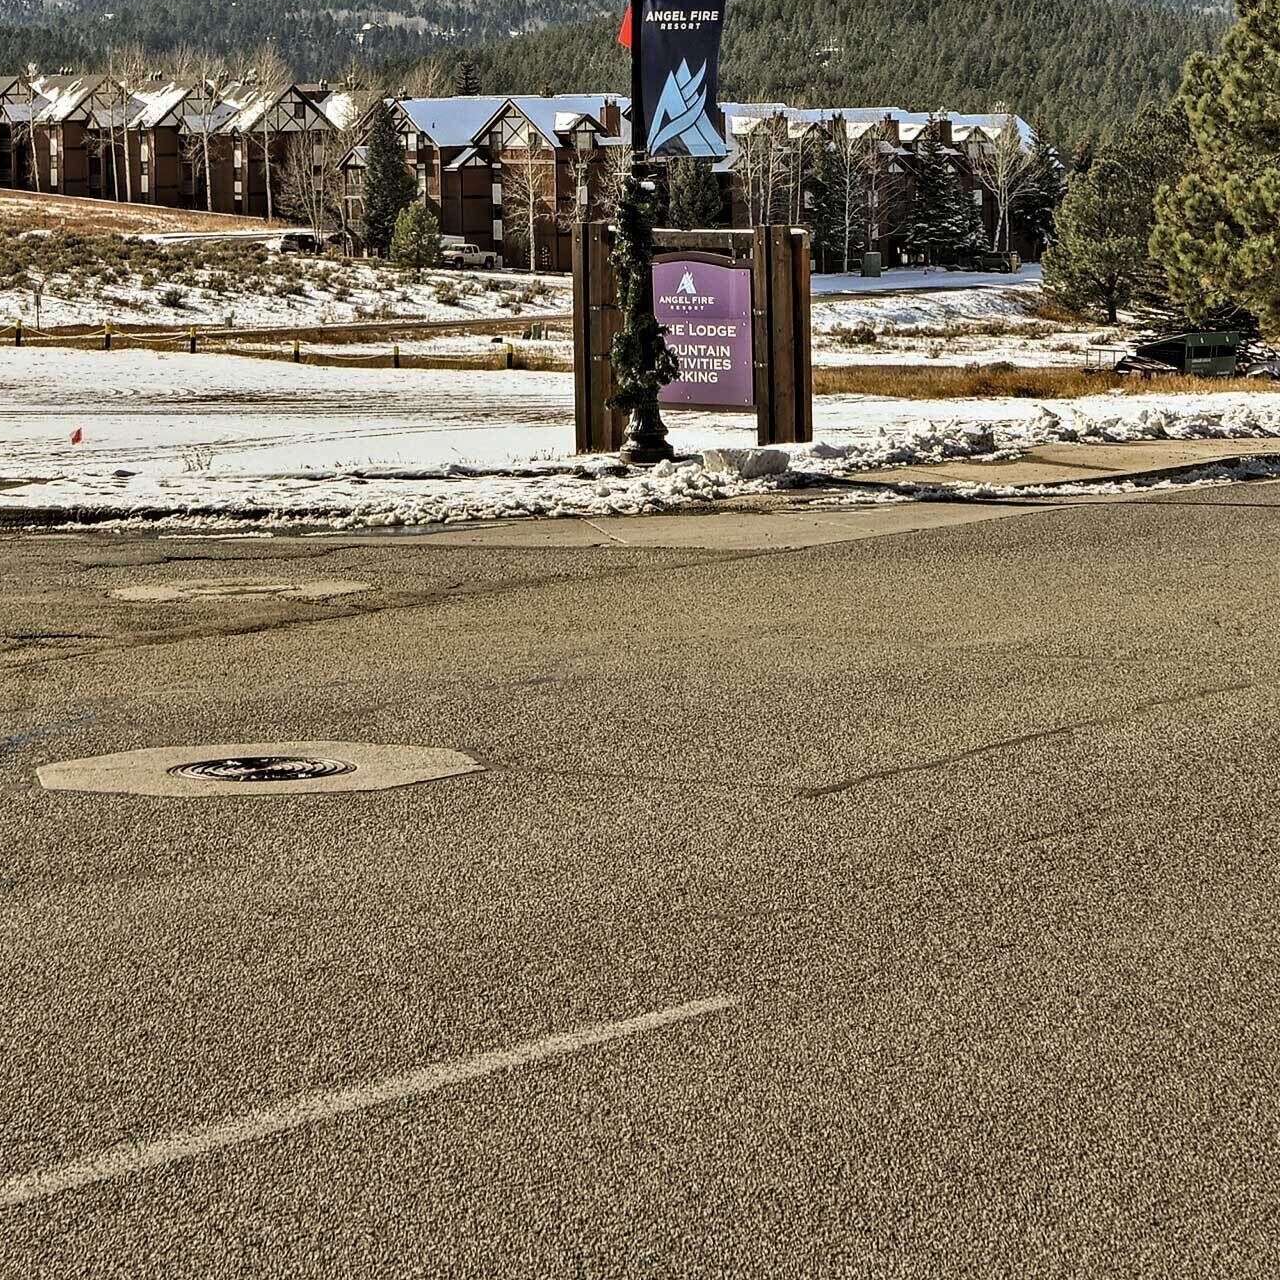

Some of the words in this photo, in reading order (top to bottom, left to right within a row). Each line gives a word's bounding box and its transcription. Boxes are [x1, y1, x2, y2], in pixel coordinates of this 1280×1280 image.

[645, 10, 687, 22] ANGEL
[690, 10, 719, 21] FIRE
[660, 22, 701, 30] RESORT
[659, 296, 691, 304] ANGEL
[692, 296, 715, 305] FIRE
[688, 323, 737, 337] LODGE
[666, 344, 731, 357] OUNTAIN
[675, 357, 732, 371] TIVITIES
[674, 370, 719, 384] RKING
